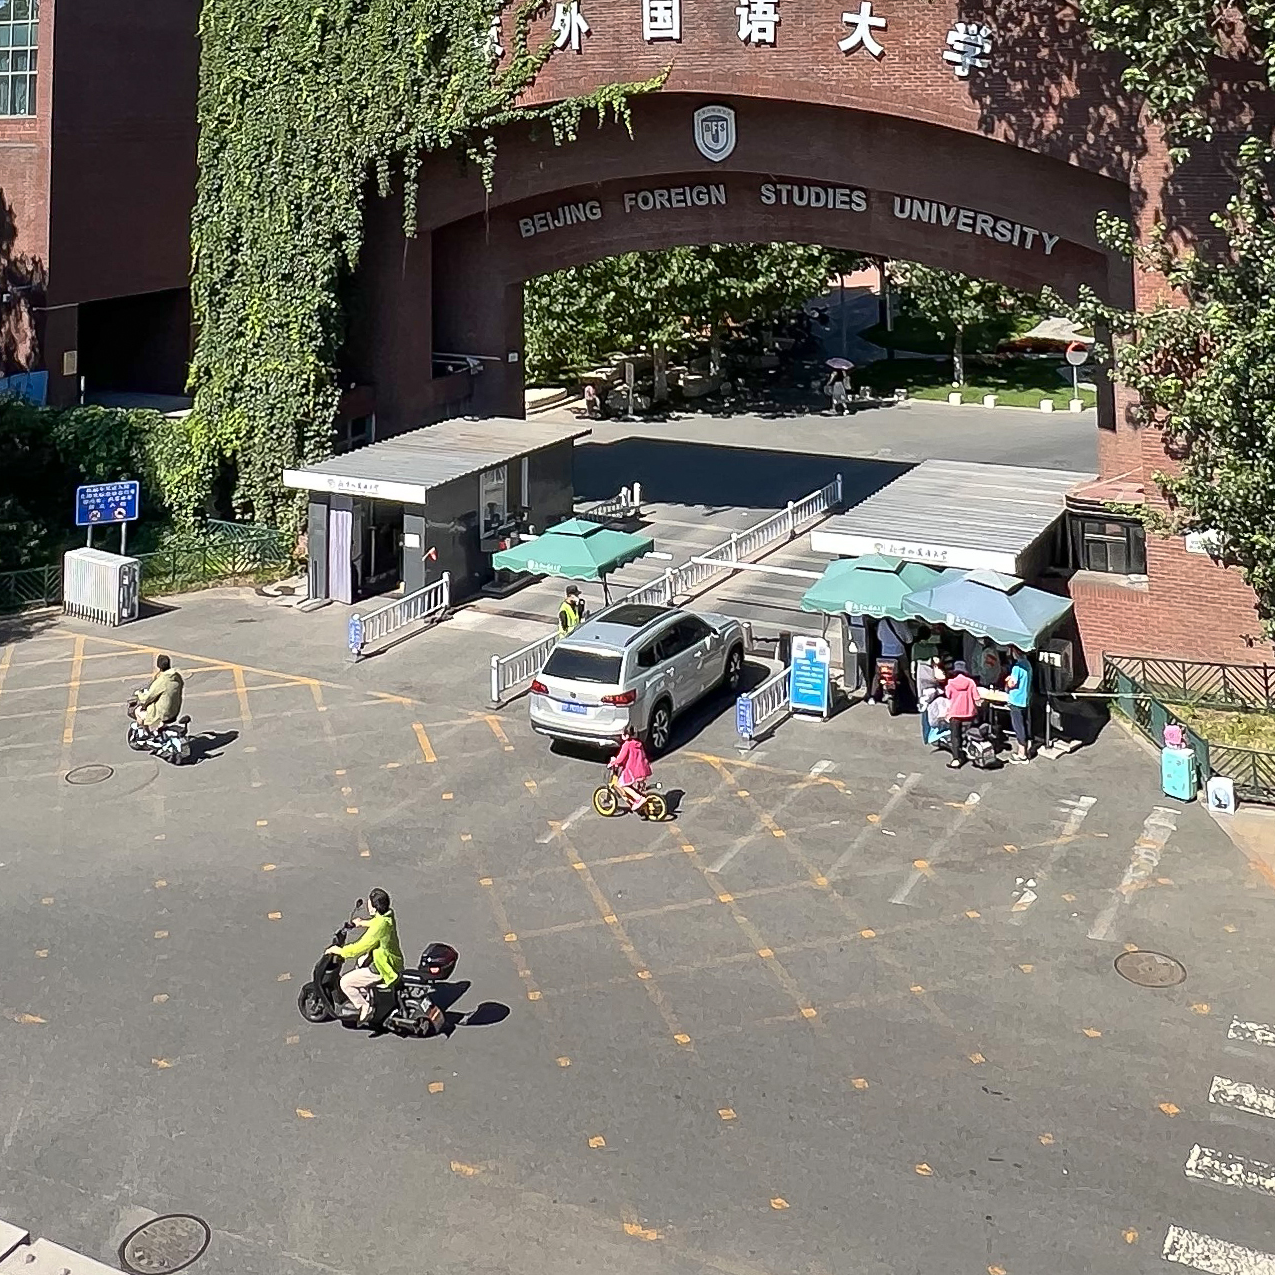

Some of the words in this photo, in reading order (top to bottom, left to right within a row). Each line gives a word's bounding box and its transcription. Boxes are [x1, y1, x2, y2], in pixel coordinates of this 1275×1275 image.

[519, 200, 602, 238] BEIJING
[624, 184, 726, 213] FOREIGN
[760, 183, 867, 212] STUDIES
[893, 196, 1060, 255] UNIVERSITY
